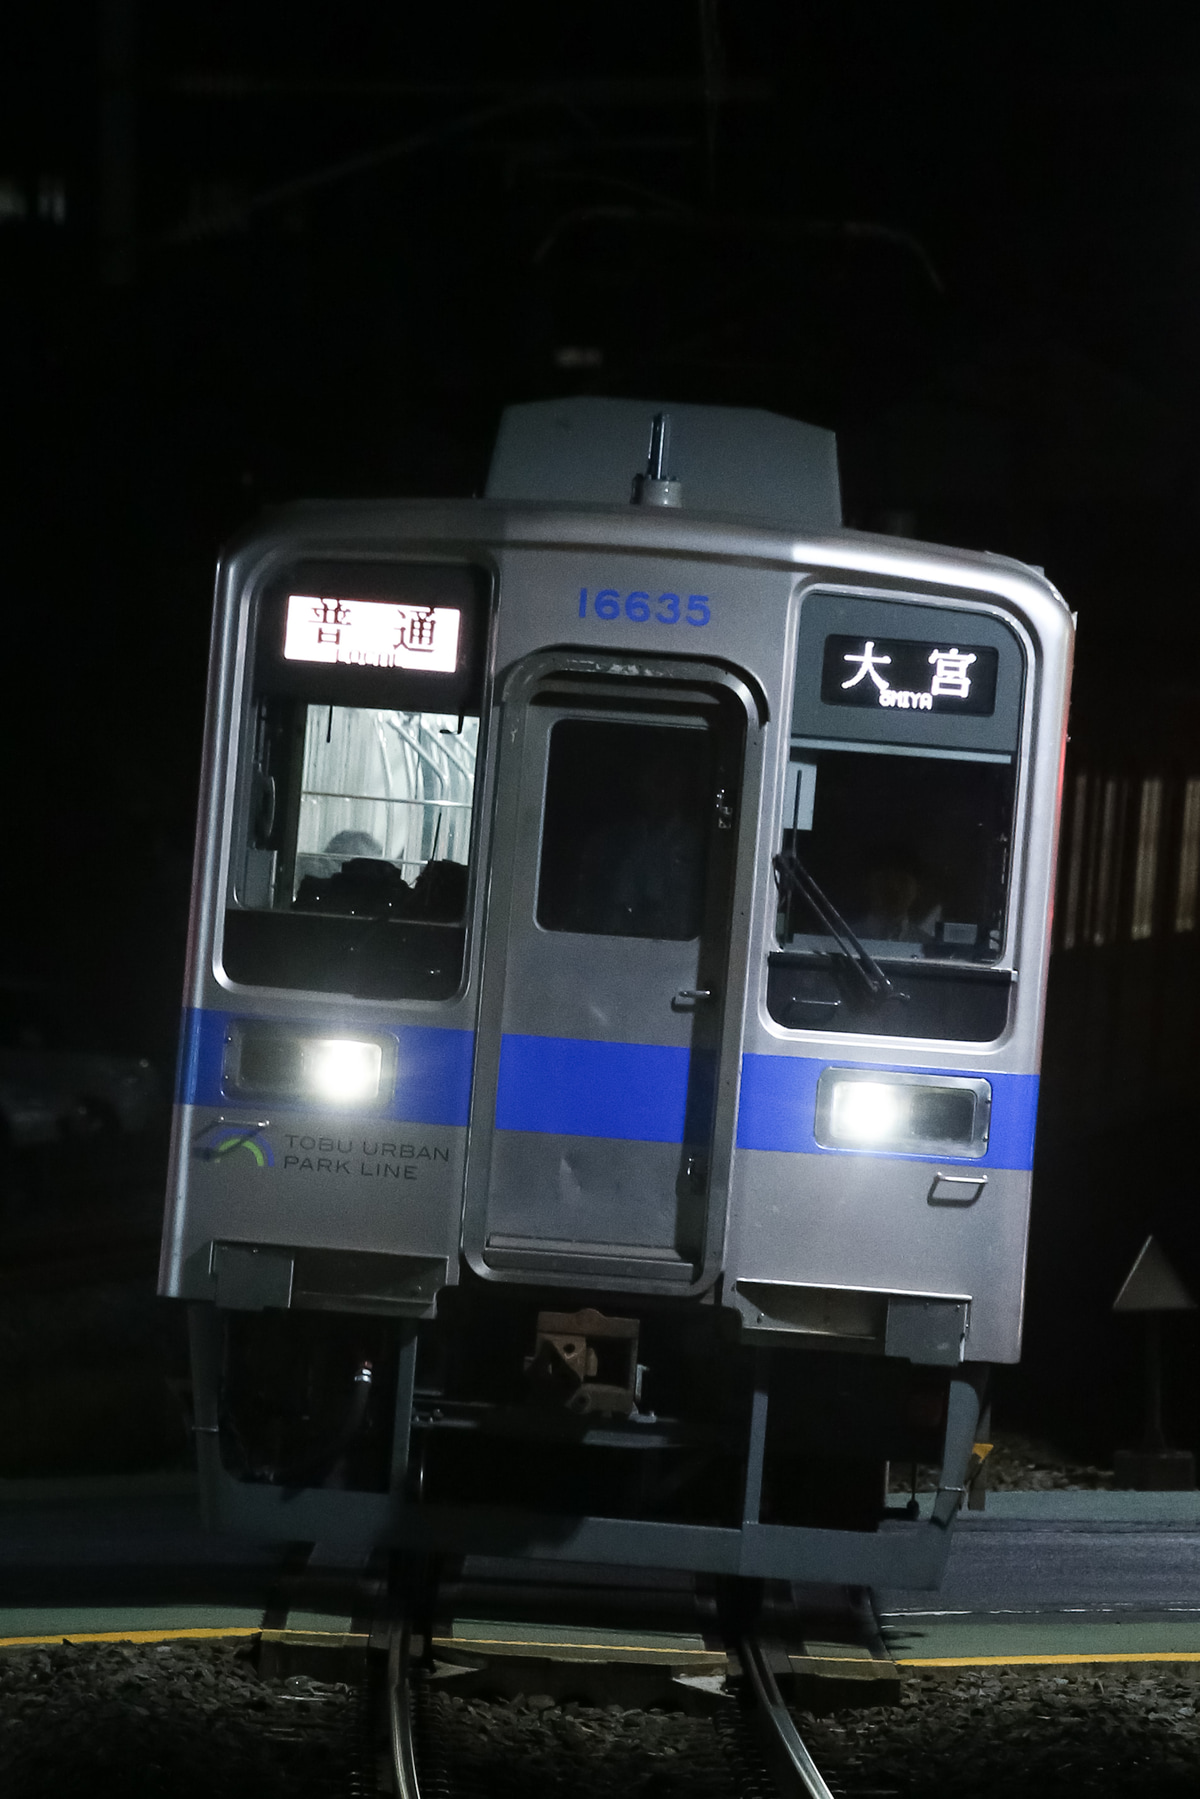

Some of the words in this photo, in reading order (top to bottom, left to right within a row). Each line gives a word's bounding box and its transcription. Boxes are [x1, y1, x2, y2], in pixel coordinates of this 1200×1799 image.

[308, 599, 436, 653] 普通
[578, 587, 711, 627] 16635
[841, 641, 977, 698] 大宮
[284, 1134, 352, 1151] TOBU
[363, 1141, 449, 1162] URBAN
[284, 1155, 350, 1175] PARK
[361, 1163, 418, 1180] LINE
